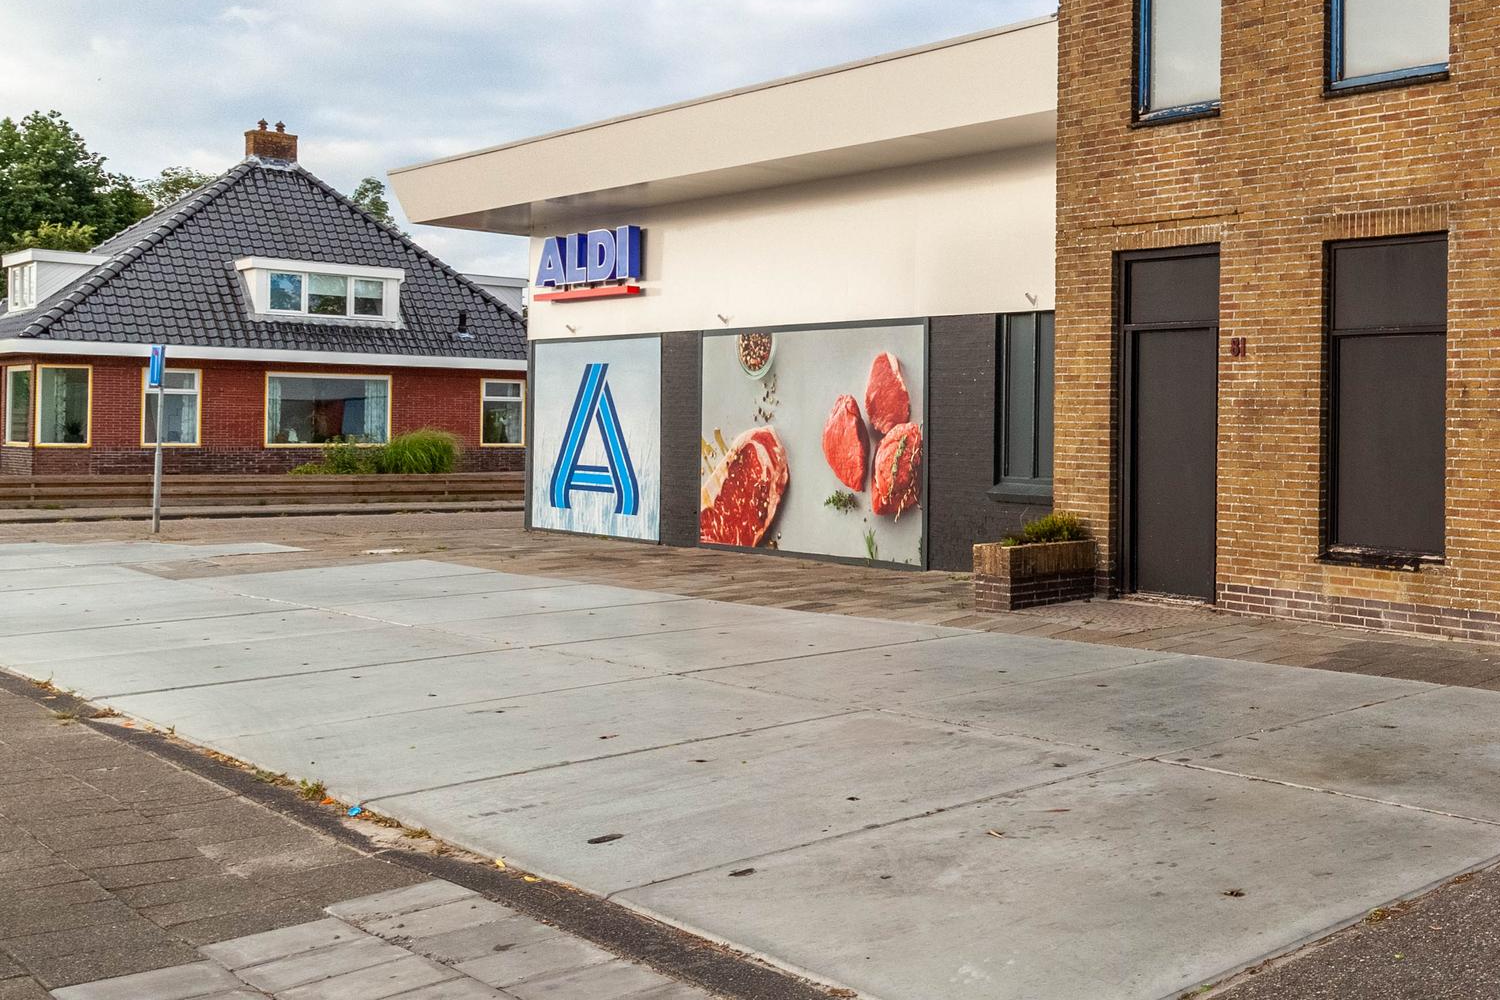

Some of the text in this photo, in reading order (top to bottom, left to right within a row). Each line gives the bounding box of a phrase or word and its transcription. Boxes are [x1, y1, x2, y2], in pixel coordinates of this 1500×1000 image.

[535, 225, 640, 287] ALDI
[1231, 337, 1247, 357] 81
[550, 363, 639, 516] A
